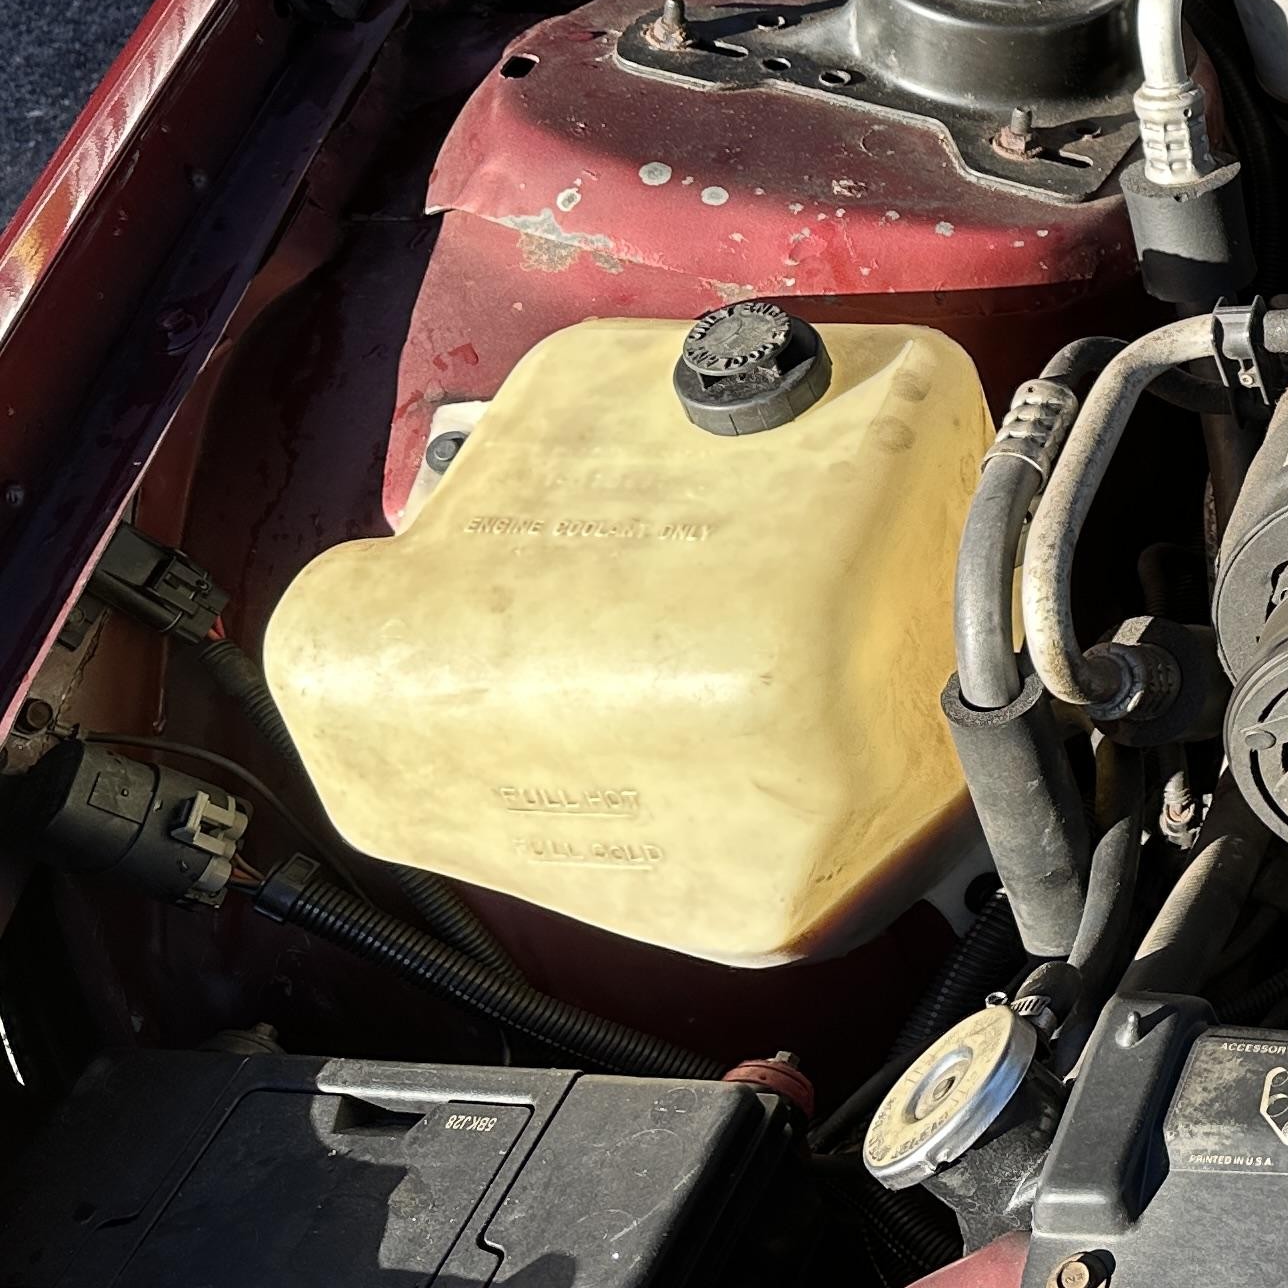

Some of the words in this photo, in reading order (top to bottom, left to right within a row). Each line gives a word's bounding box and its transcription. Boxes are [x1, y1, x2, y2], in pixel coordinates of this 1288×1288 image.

[463, 516, 544, 536] ENGINE
[552, 518, 649, 539] COOLANT
[657, 523, 714, 542] ONLY
[500, 787, 580, 808] FULL
[584, 789, 639, 809] HOT
[512, 838, 584, 860] FULL
[591, 843, 665, 862] COLD
[1189, 1154, 1232, 1165] PRINTED
[1233, 1155, 1245, 1165] IN
